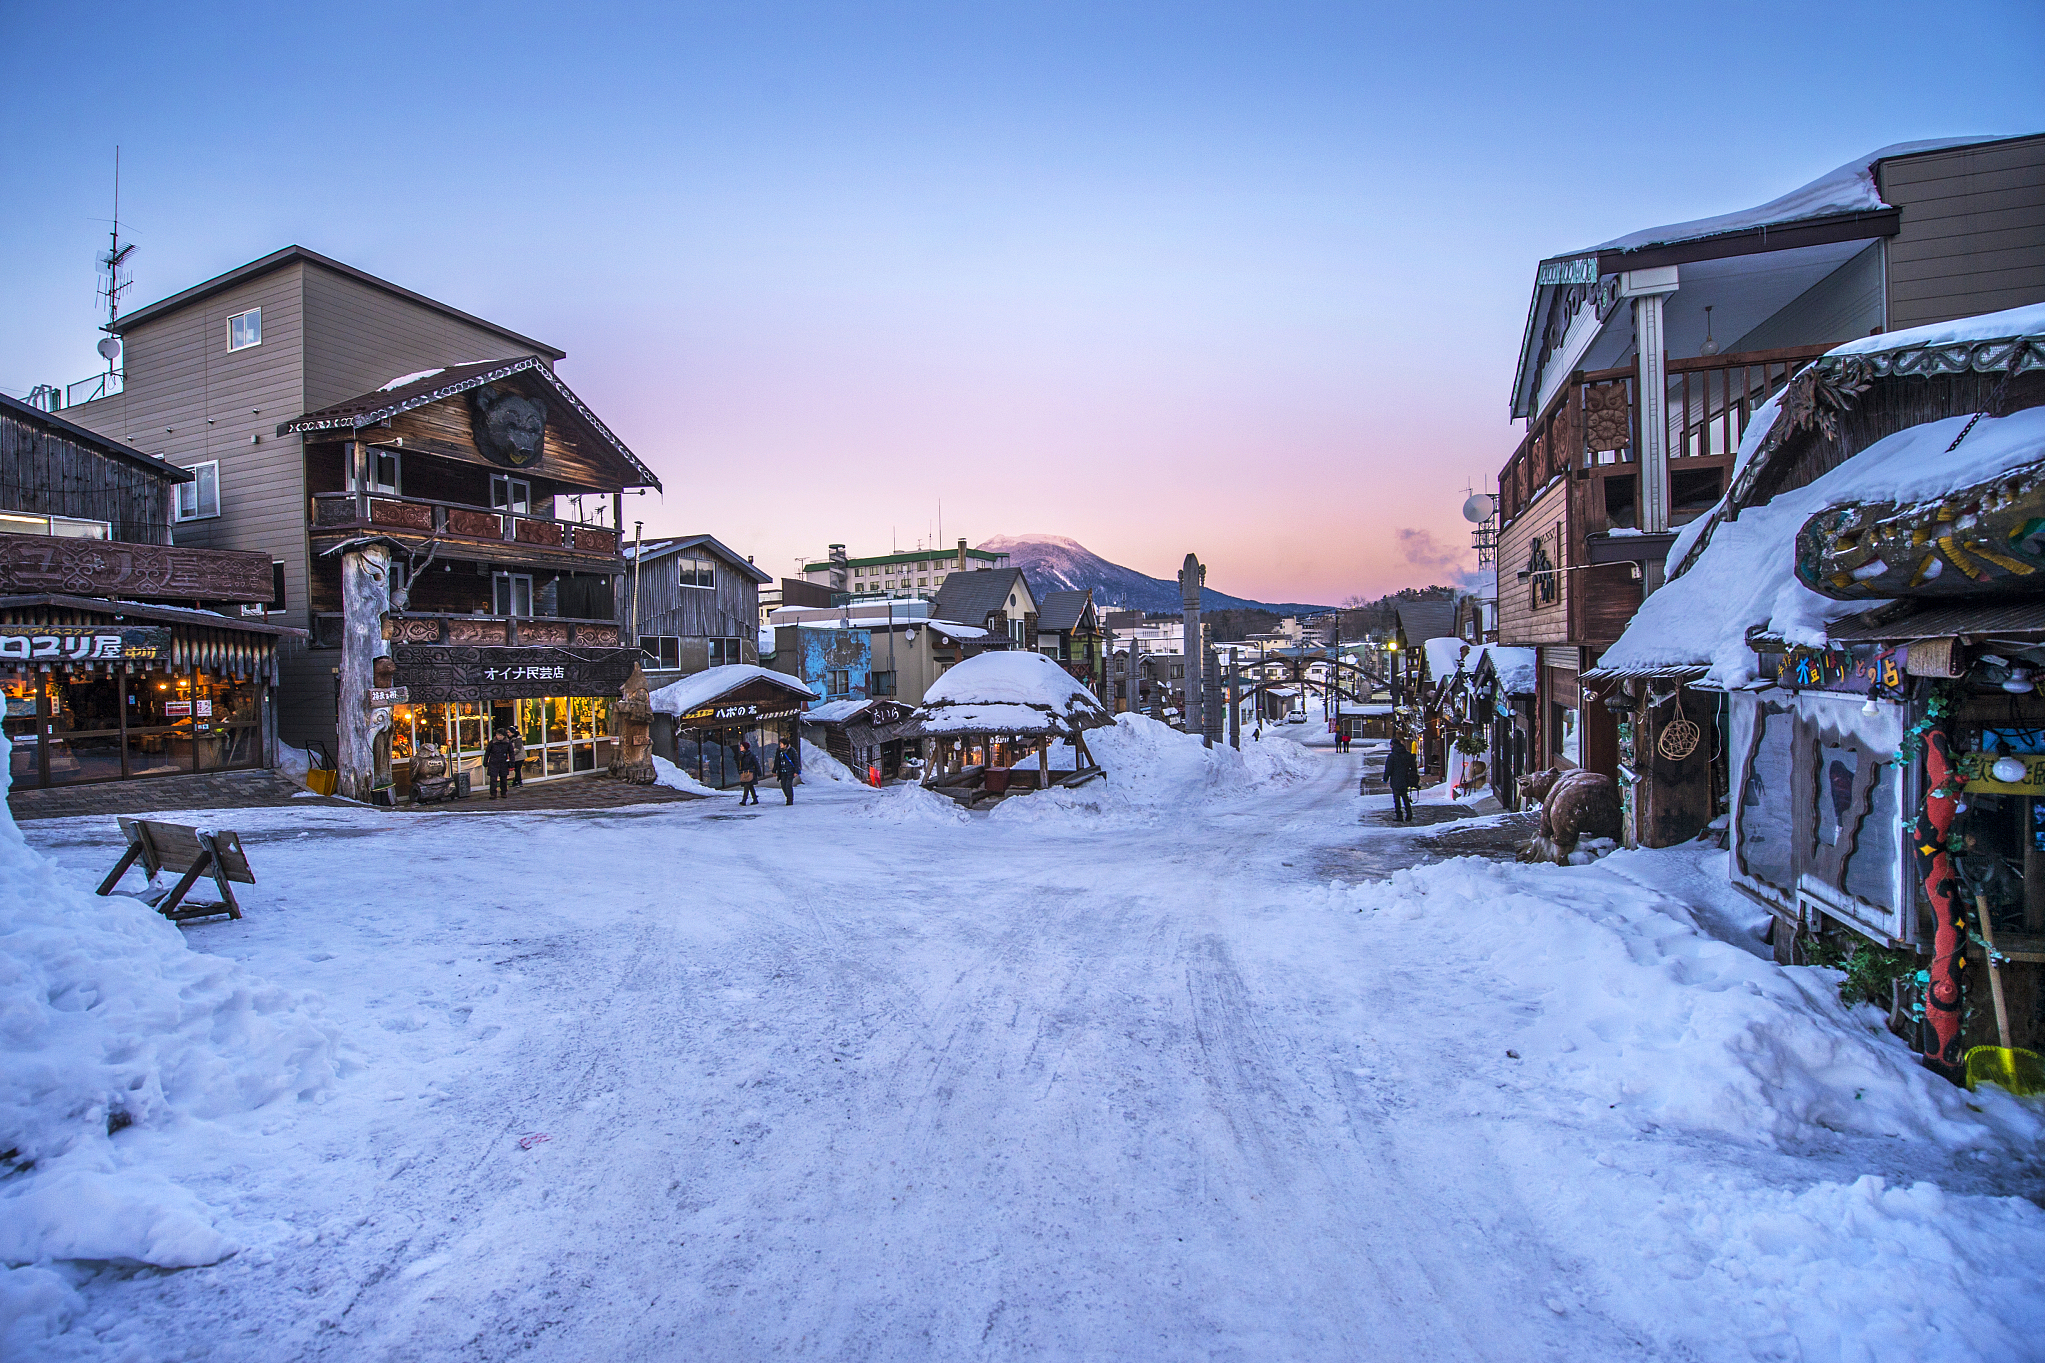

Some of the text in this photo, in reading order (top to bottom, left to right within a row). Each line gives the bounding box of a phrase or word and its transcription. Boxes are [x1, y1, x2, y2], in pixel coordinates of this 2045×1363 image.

[125, 646, 157, 659] 中川
[484, 665, 565, 680] オイナ民芸店
[873, 706, 900, 724] たいら
